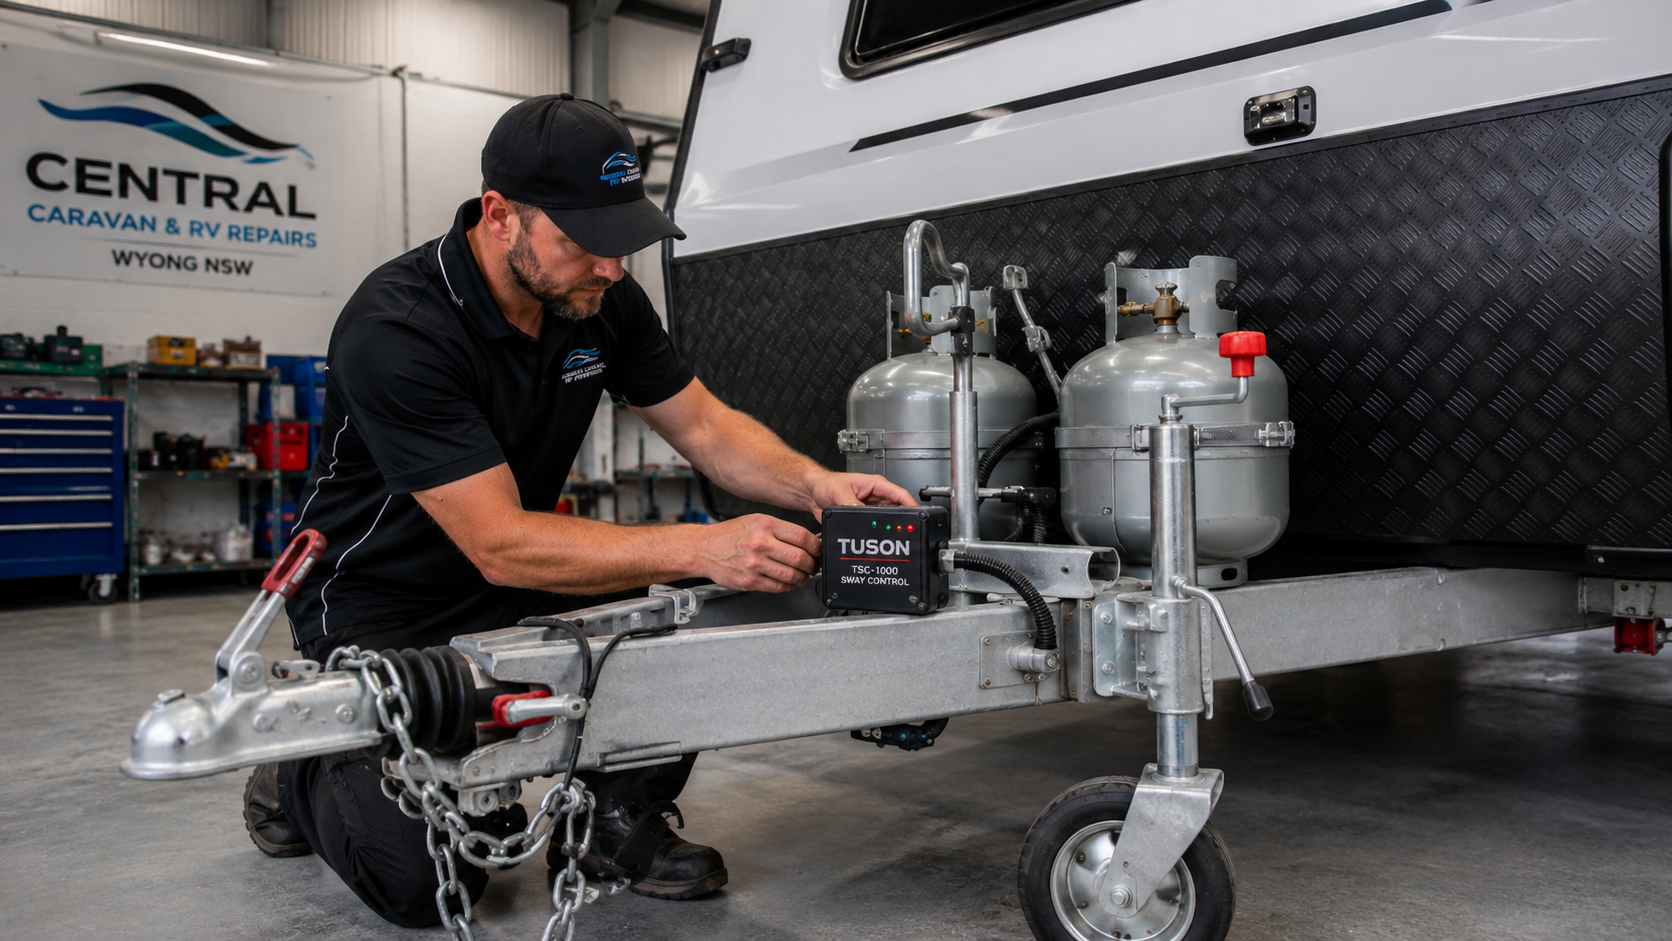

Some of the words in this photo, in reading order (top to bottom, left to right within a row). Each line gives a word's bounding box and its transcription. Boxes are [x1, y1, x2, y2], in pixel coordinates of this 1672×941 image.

[26, 152, 317, 220] CENTRAL
[27, 204, 157, 232] CARAVAN
[165, 218, 181, 235] &
[189, 220, 221, 239] RV
[228, 226, 318, 248] REPAIRS
[112, 249, 198, 271] WYONG
[205, 258, 254, 275] NSW
[837, 538, 910, 556] TUSON
[840, 576, 866, 585] SWAY
[867, 577, 910, 586] CONTROL
[851, 565, 899, 575] TSC-1000
